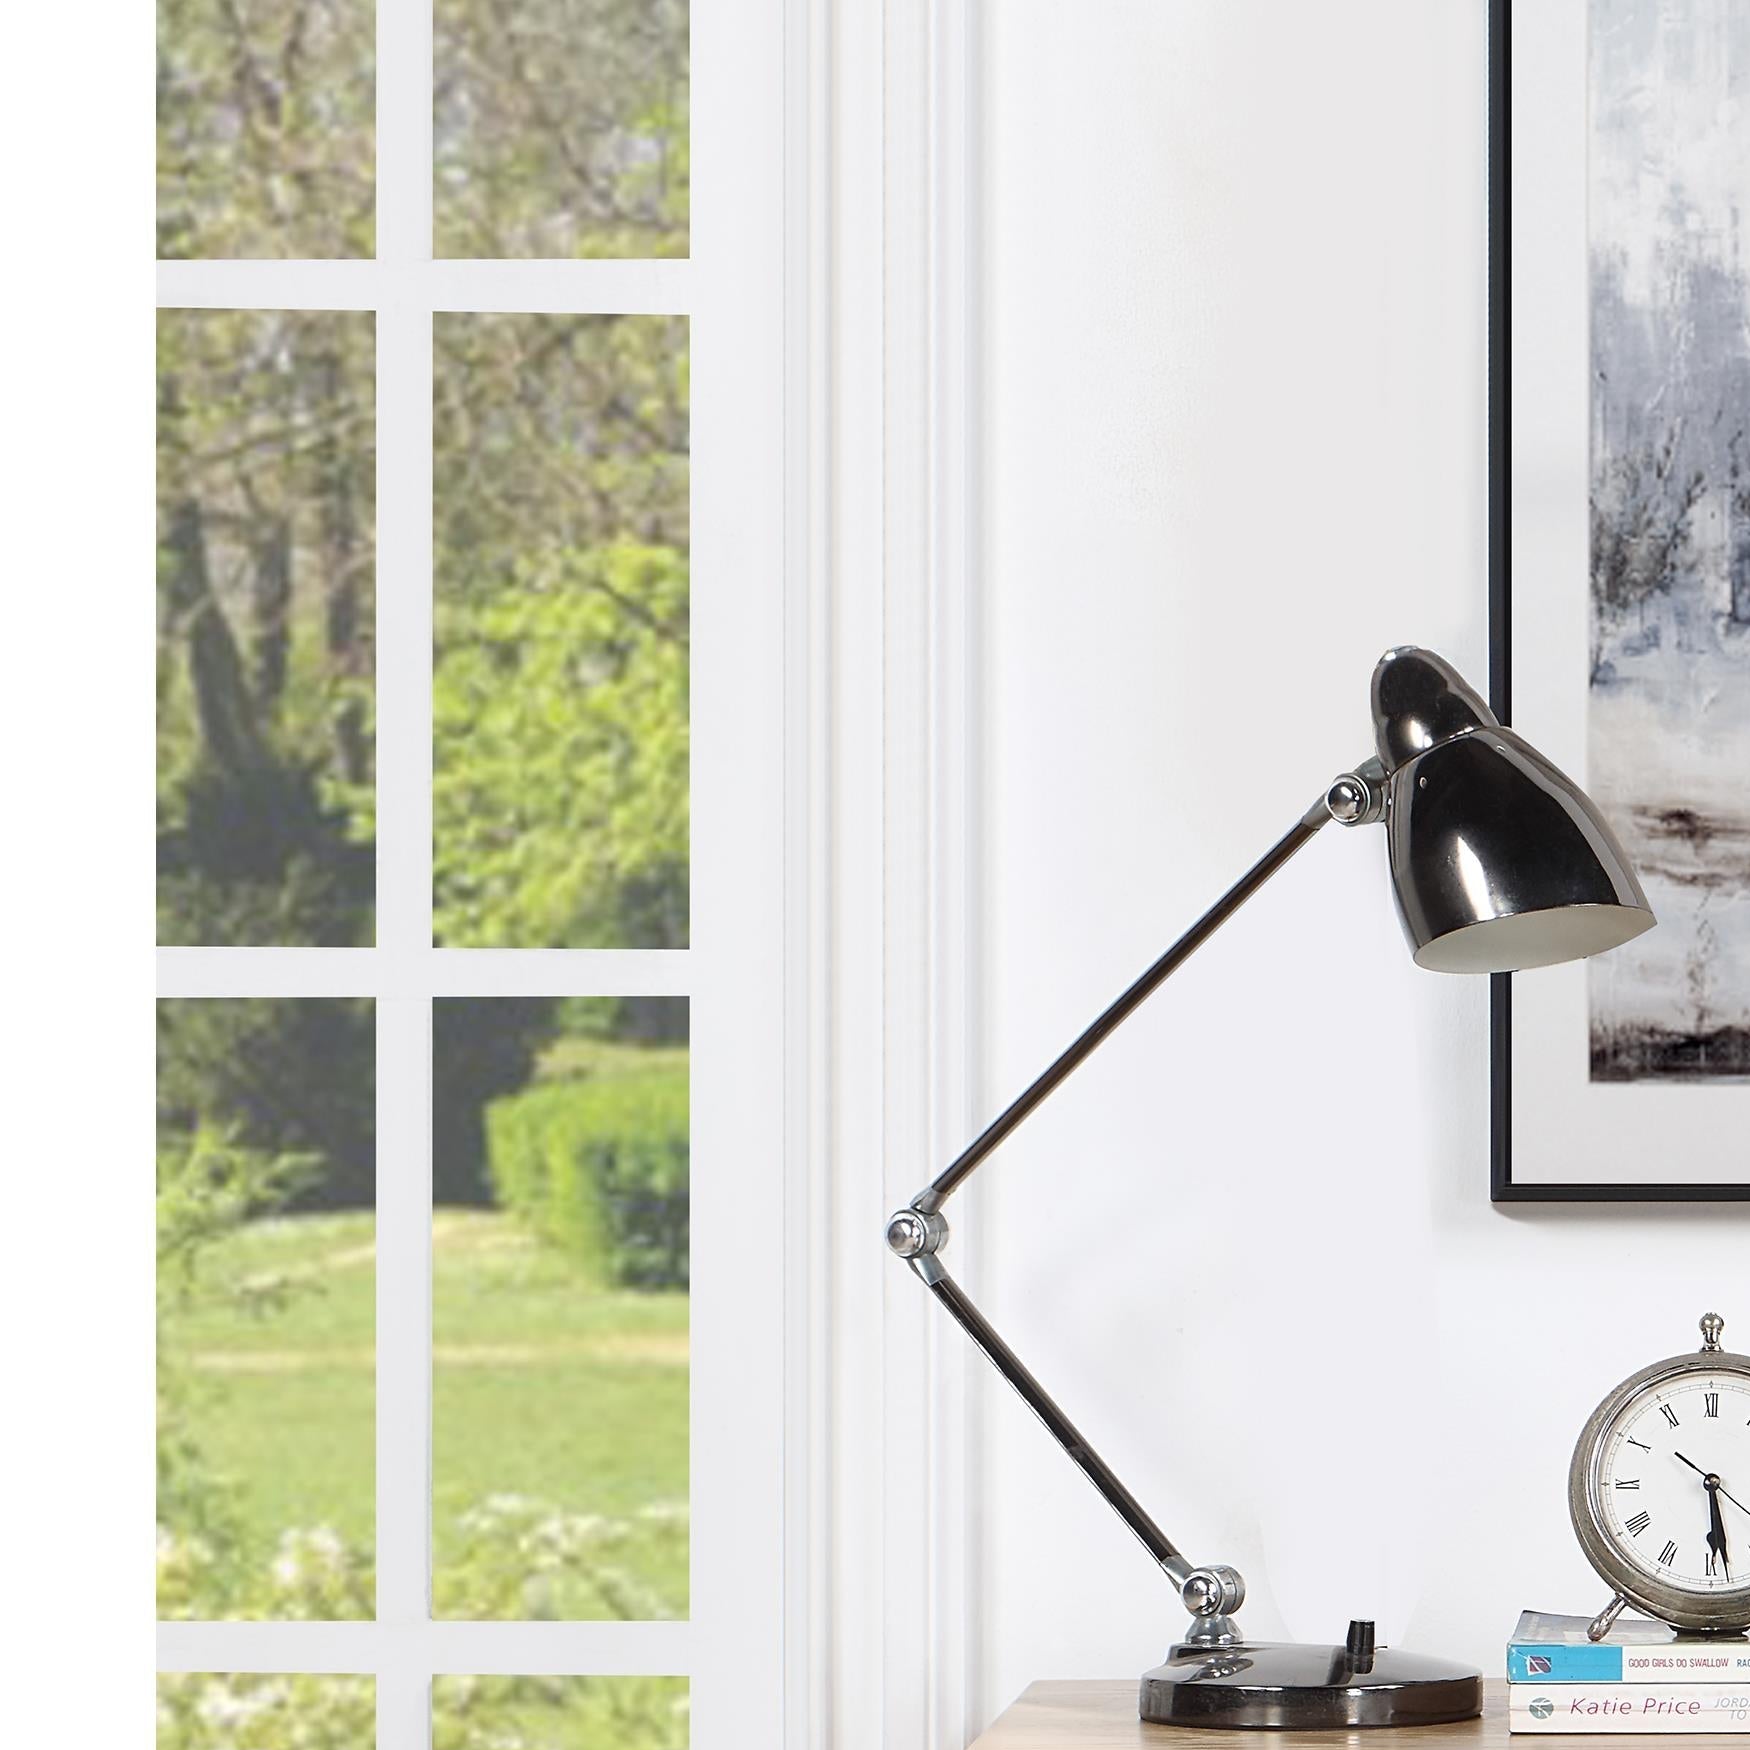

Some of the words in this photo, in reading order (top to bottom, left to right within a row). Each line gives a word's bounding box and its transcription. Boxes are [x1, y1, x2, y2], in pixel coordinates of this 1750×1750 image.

[1704, 1393, 1719, 1418] XII
[1659, 1403, 1680, 1429] XI
[1627, 1435, 1651, 1454] X
[1615, 1478, 1640, 1489] IX
[1624, 1511, 1651, 1538] VIII
[1657, 1540, 1679, 1567] VII
[1628, 1658, 1649, 1668] GOOD
[1652, 1658, 1673, 1668] GIRLS
[1676, 1658, 1687, 1668] DO
[1689, 1658, 1729, 1668] SWALLOW
[1570, 1697, 1632, 1715] Katie
[1643, 1697, 1701, 1715] Price
[1729, 1709, 1747, 1720] TO
